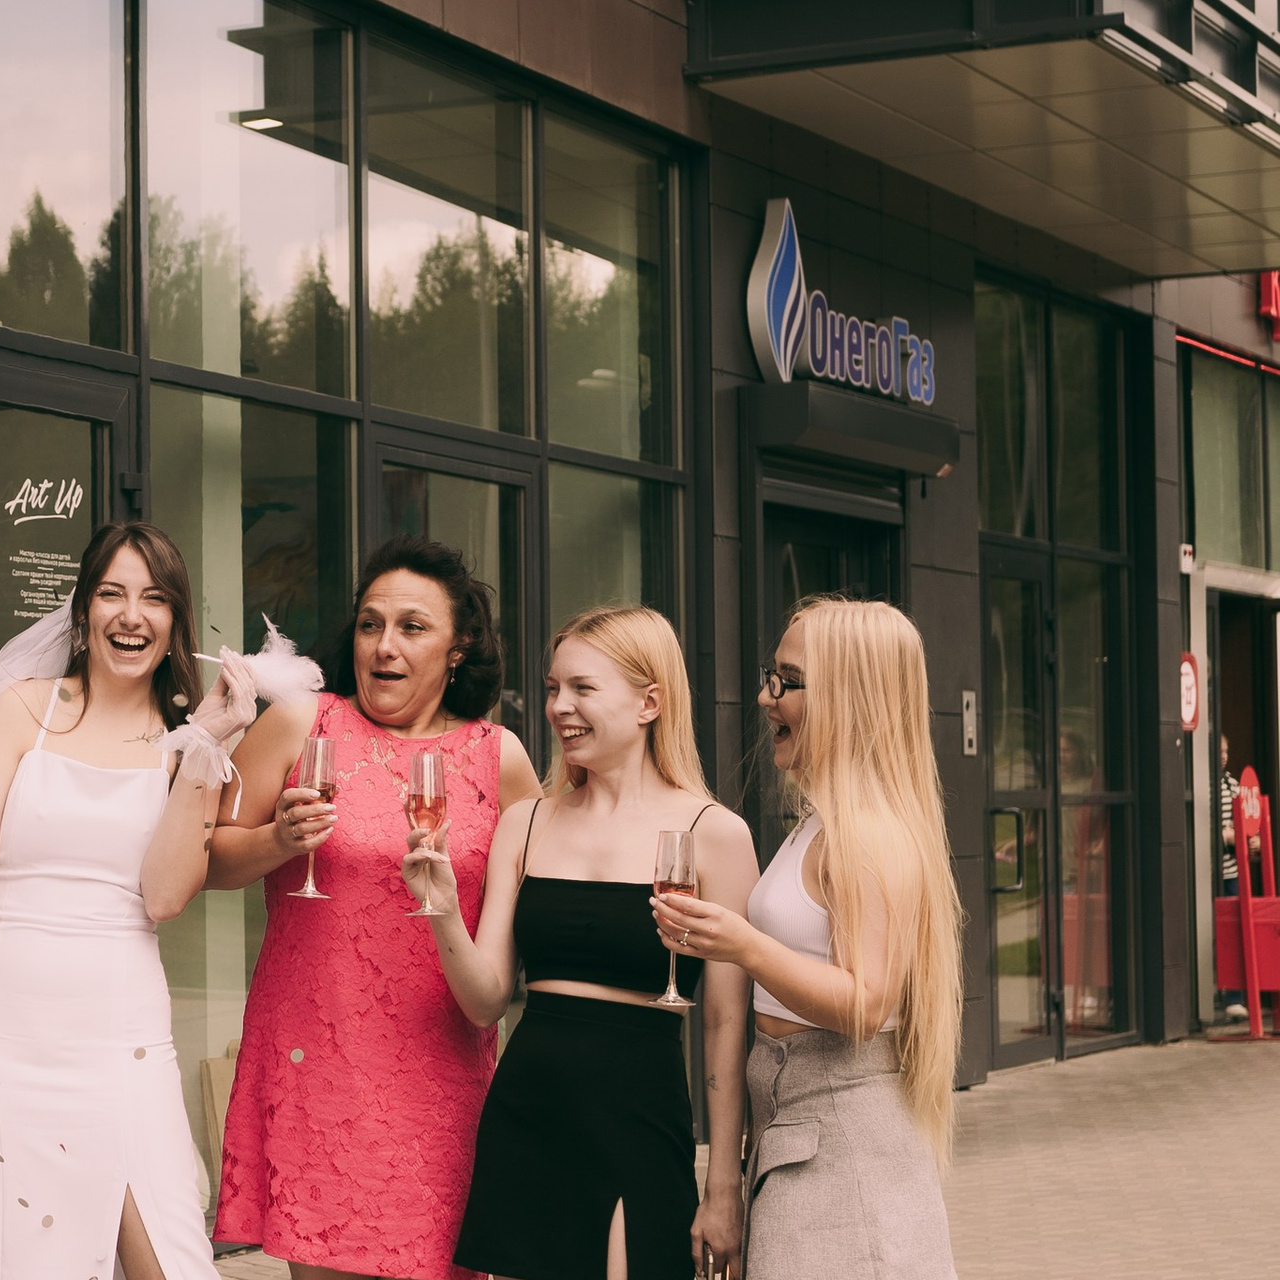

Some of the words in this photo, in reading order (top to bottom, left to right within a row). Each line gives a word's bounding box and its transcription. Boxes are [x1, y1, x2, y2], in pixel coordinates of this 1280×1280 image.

[808, 289, 935, 406] ОнегоГаз
[4, 478, 54, 516] Art
[54, 477, 84, 519] Up
